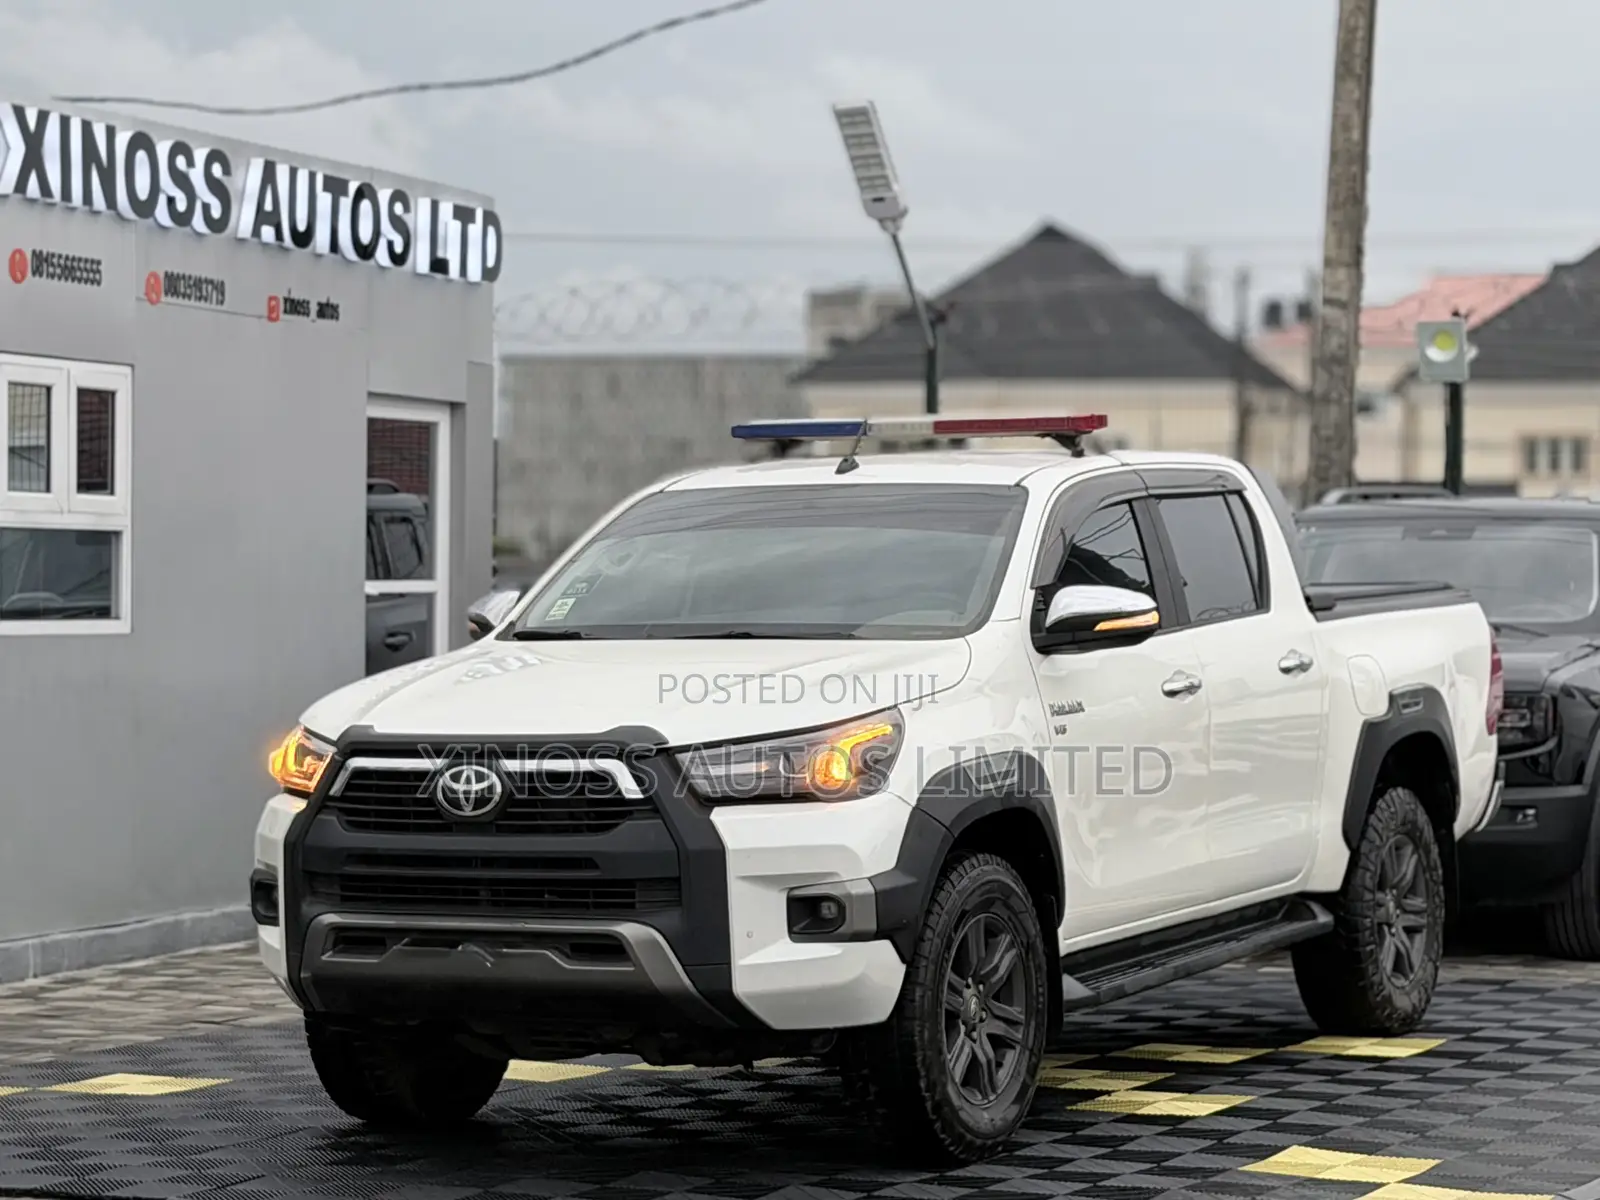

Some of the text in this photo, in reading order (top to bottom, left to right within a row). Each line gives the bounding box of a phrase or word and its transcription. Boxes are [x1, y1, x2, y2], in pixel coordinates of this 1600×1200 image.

[4, 104, 503, 284] XINOSS AUTOS LTD
